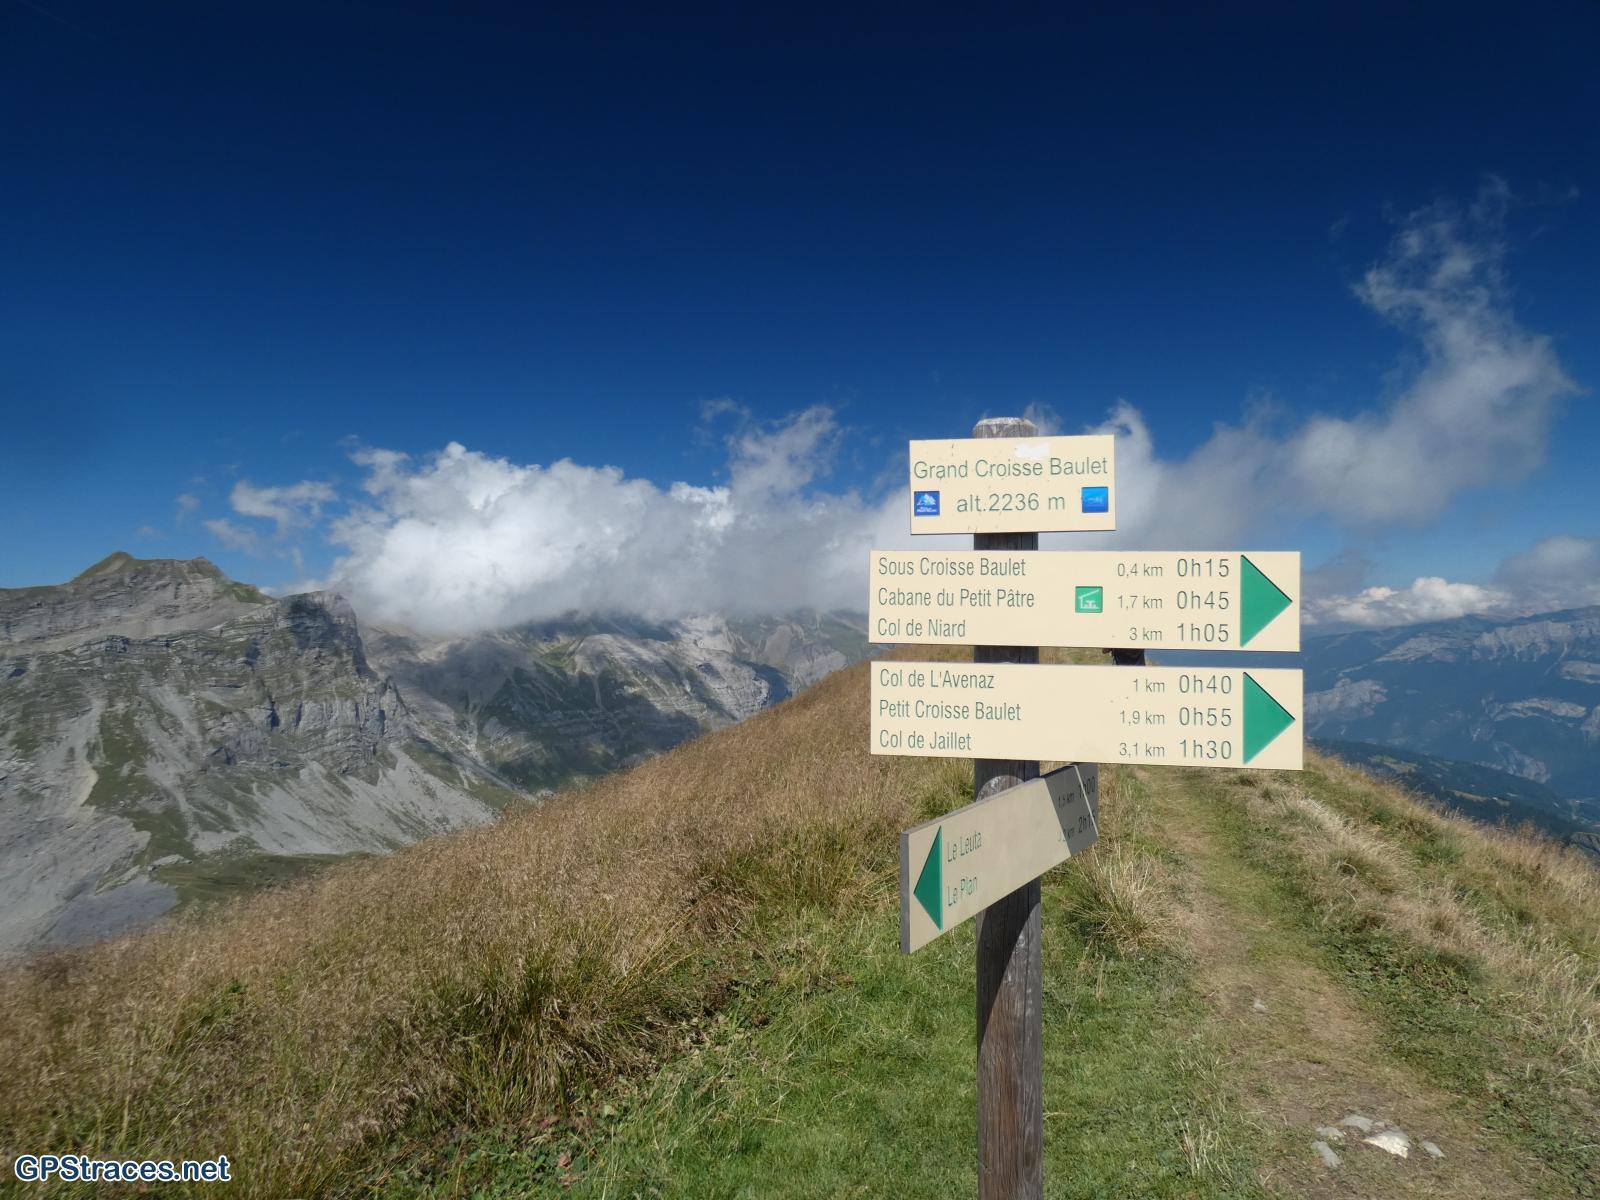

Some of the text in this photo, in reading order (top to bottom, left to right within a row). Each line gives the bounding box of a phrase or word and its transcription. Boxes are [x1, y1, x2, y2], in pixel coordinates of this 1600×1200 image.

[913, 456, 1108, 479] Grand Croisse Baulet
[956, 492, 1040, 512] alt.2236
[1048, 496, 1065, 510] m
[878, 557, 1230, 578] Sous Croisse Baulet 0,4 km 0h15
[878, 587, 1230, 610] Cabane du Petit Pâtre 1,7 km 0h45
[877, 617, 1229, 642] Col de Niard 3 km 1h05
[880, 668, 1232, 694] Col de L'Avenaz 1 km 0h40
[879, 699, 1232, 726] Petit Croisse Baulet 1,9 km 0h55
[879, 729, 1232, 759] Col de Jaillet 3,1 km 1h30
[947, 841, 957, 862] Le
[960, 831, 982, 856] Leuta
[947, 885, 958, 907] Le
[960, 876, 978, 899] Plan
